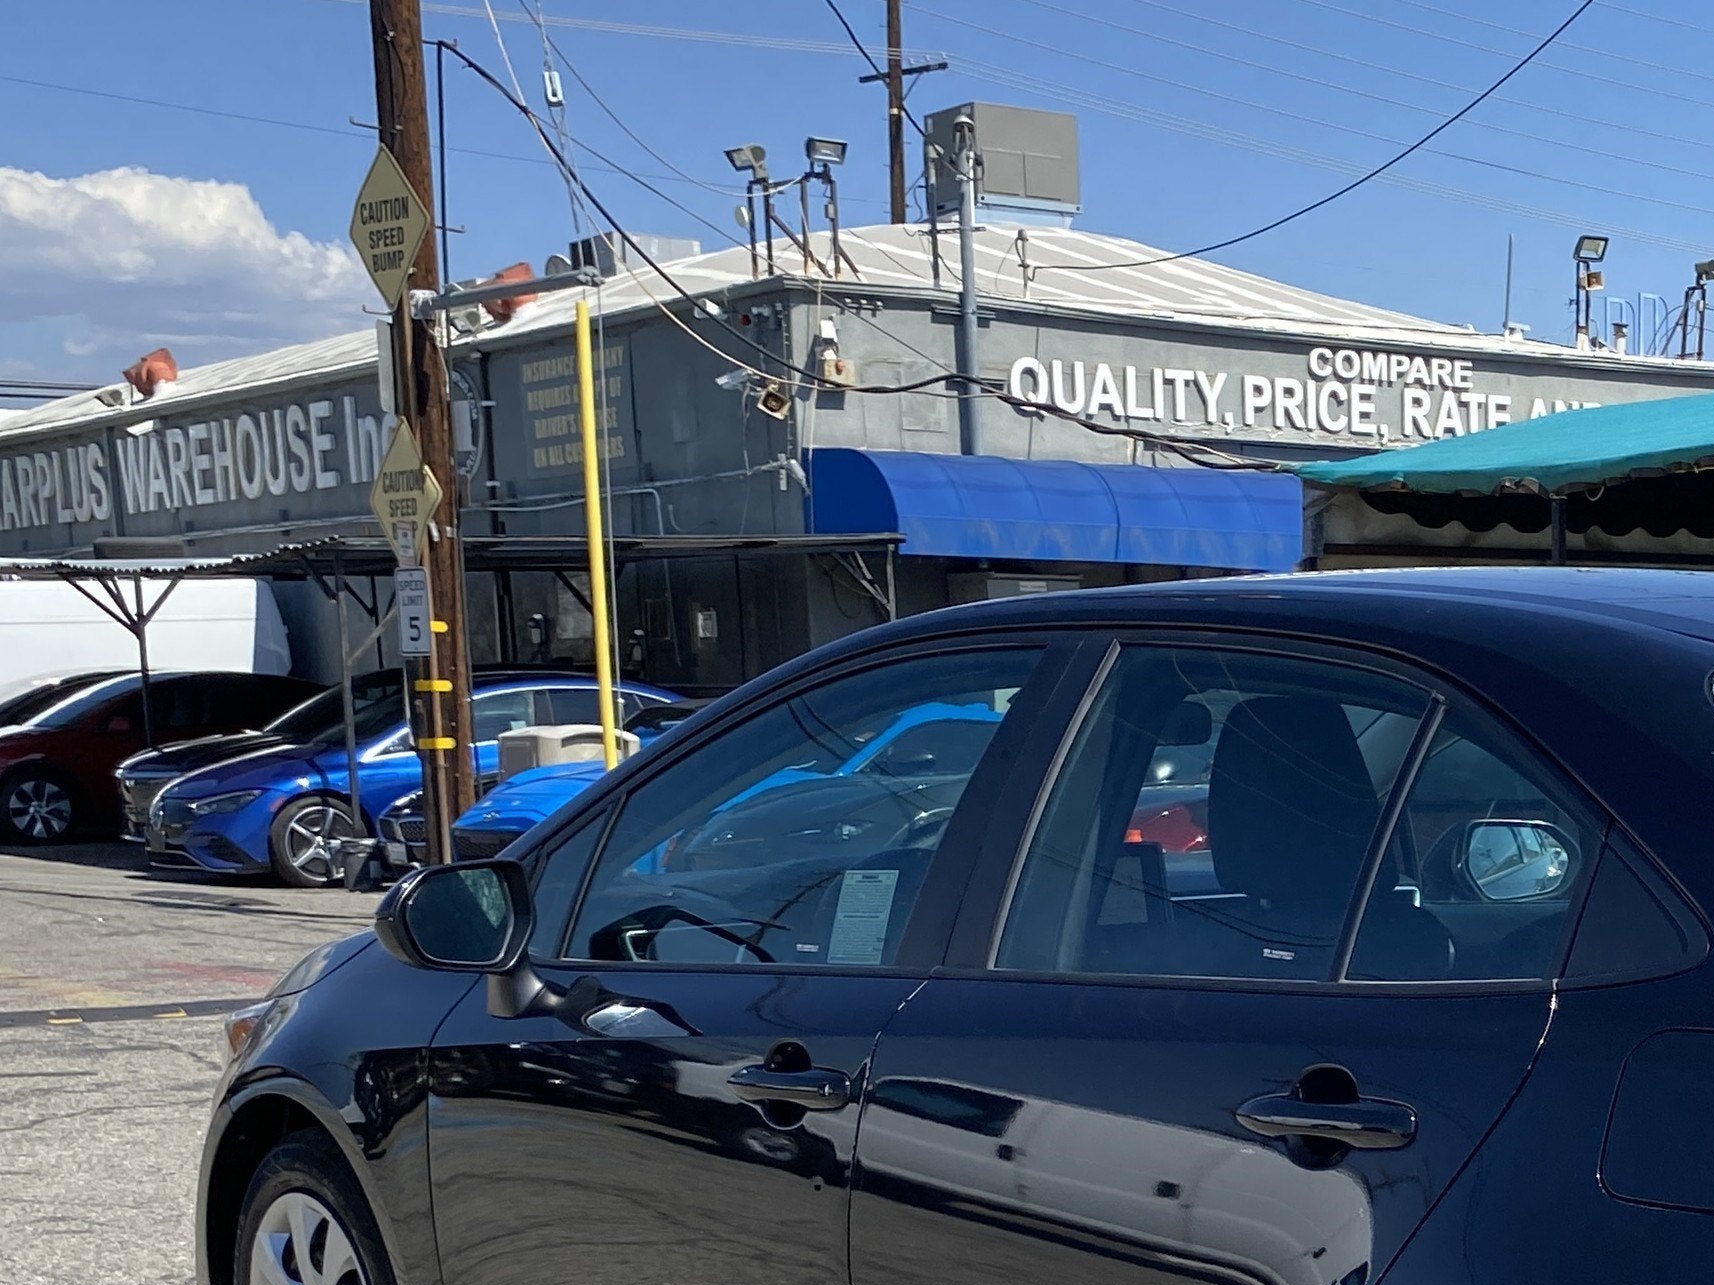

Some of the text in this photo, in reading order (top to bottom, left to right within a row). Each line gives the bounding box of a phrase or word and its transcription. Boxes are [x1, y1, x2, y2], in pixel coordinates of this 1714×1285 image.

[360, 196, 409, 226] CAUTION
[368, 226, 405, 250] SPEED
[372, 250, 405, 273] BUMP
[1308, 348, 1474, 389] COMPARE
[1009, 356, 1234, 432] QUALITY,
[1243, 374, 1389, 444] PRICE,
[0, 443, 112, 531] ARPLUS
[116, 400, 339, 515] WAREHOUSE
[390, 498, 417, 518] SPEED
[392, 521, 418, 541] BP
[399, 580, 425, 591] SPEED
[409, 616, 421, 642] 5
